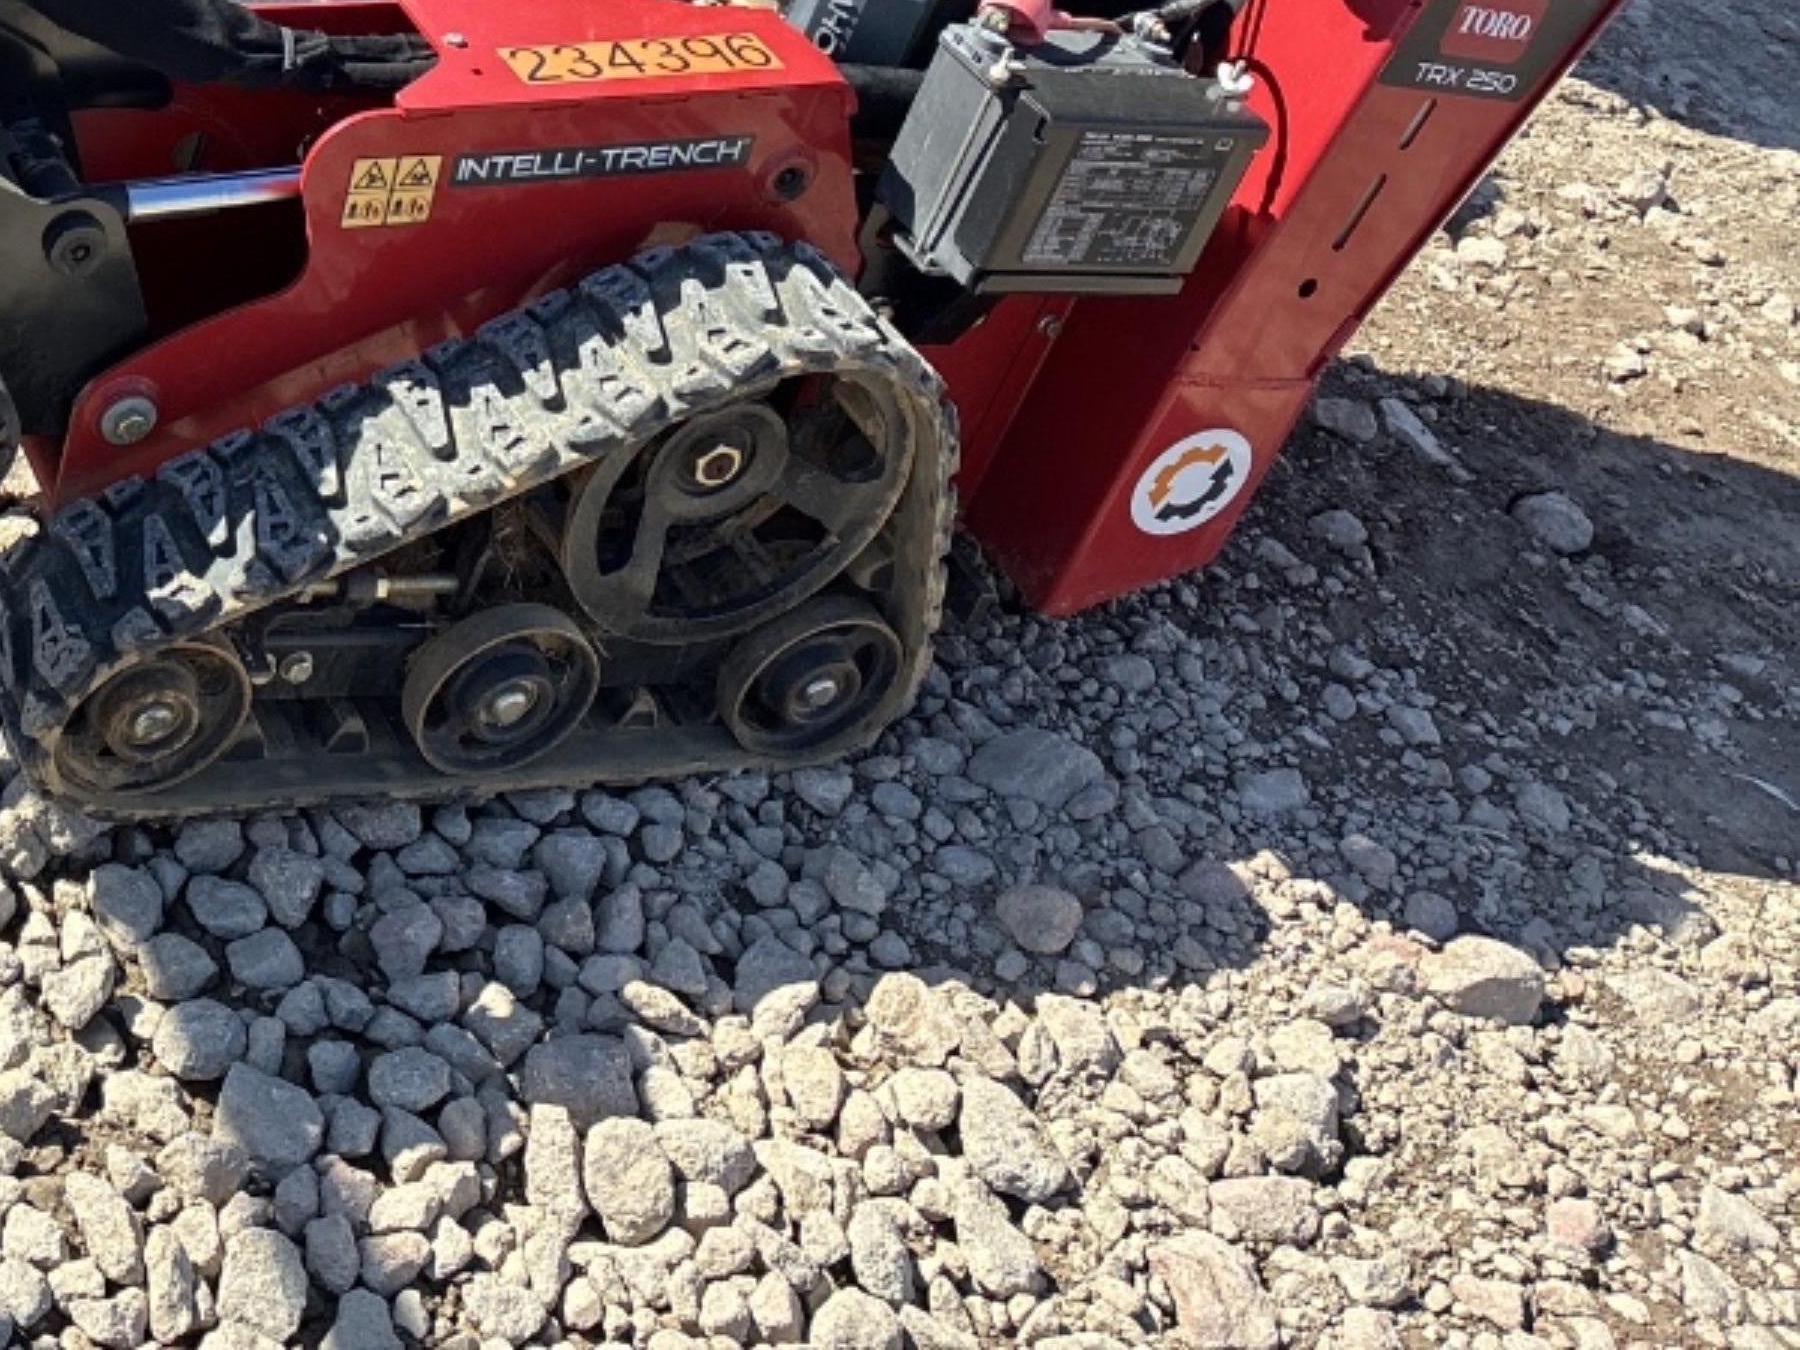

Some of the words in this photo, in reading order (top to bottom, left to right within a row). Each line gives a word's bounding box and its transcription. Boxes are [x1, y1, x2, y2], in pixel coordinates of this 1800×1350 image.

[1458, 6, 1532, 41] TORO
[508, 35, 772, 82] 234396
[1415, 62, 1464, 86] TRX
[1465, 68, 1517, 94] 250
[458, 140, 746, 181] INTELLI-TRENCH
